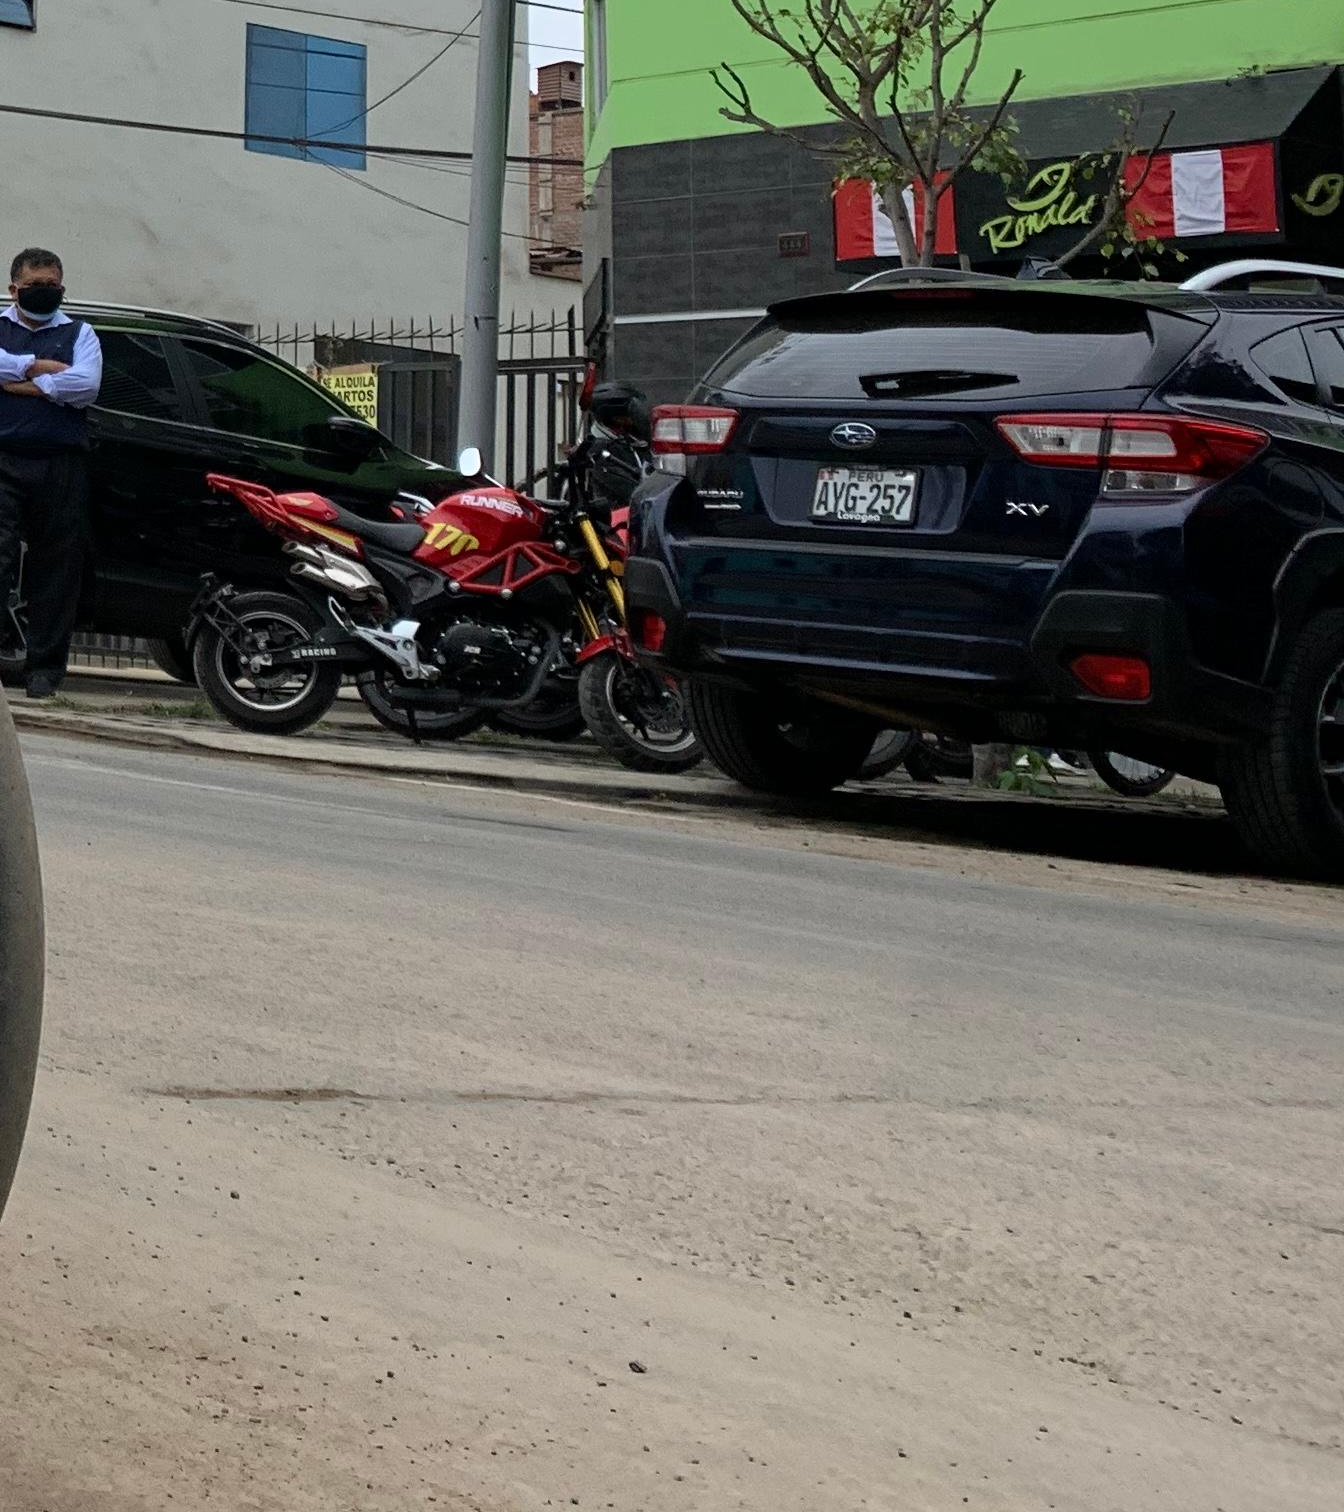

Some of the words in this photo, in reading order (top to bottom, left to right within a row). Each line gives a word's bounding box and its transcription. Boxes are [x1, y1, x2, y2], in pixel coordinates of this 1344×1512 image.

[978, 191, 1099, 255] Ronald
[334, 376, 376, 389] ALQUILA
[335, 389, 375, 403] ARTOS
[848, 470, 884, 483] PERU
[459, 494, 524, 518] RUNNER
[815, 481, 912, 515] AYG-257
[1005, 501, 1050, 517] XV
